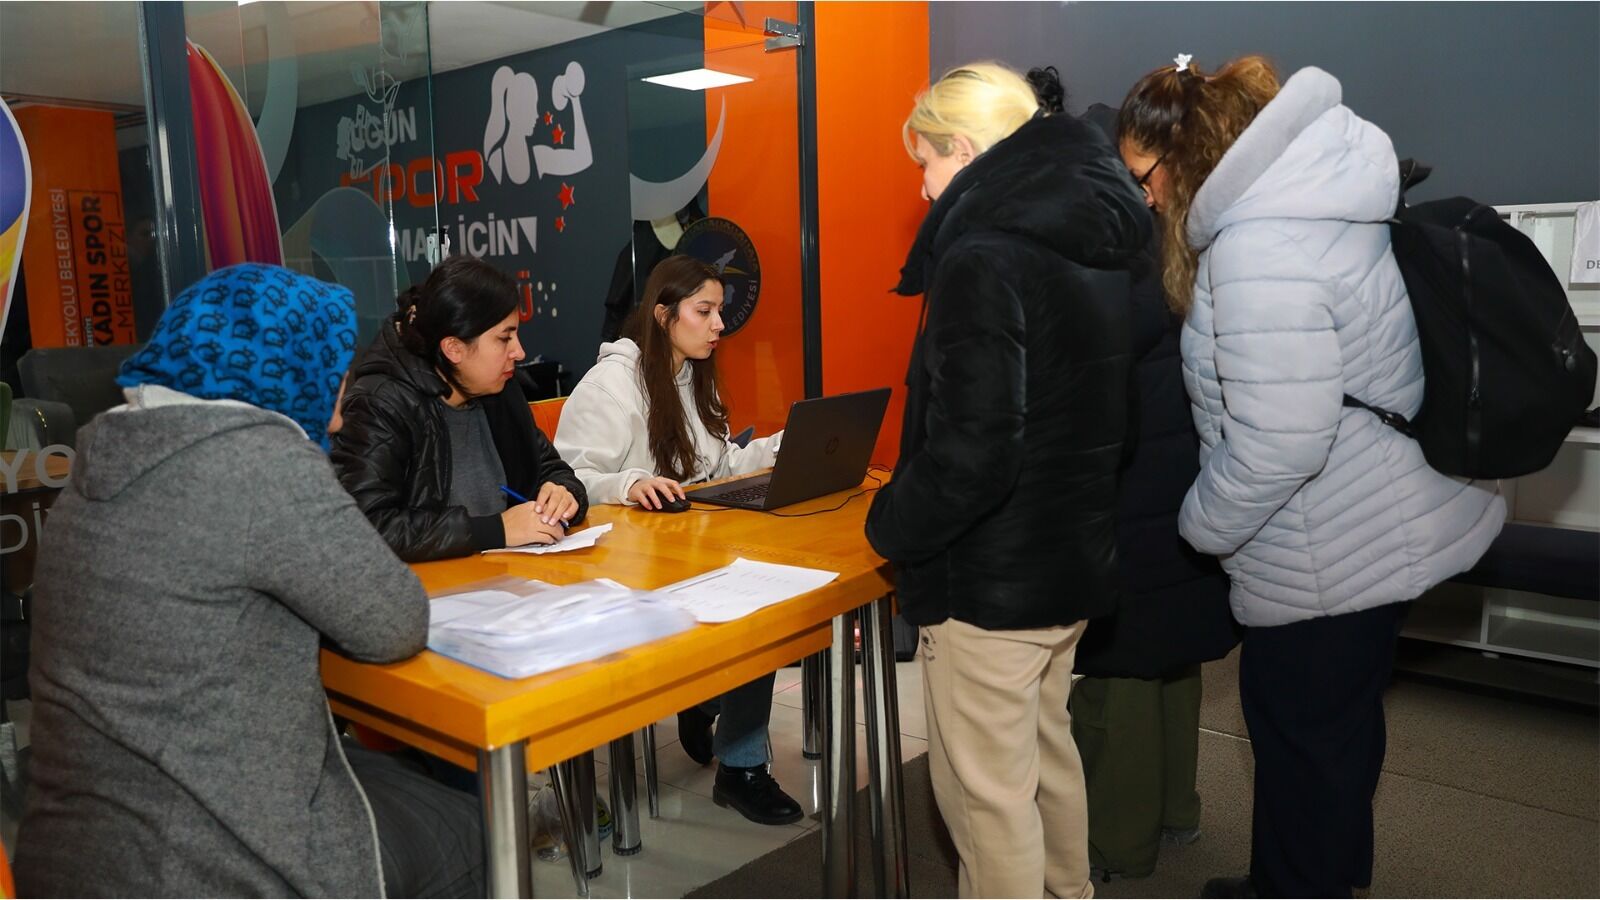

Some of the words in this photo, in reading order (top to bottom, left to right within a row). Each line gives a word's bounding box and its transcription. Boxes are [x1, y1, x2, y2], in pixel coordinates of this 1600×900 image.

[49, 188, 76, 280] BELEDİYESİ
[82, 195, 107, 266] SPOR
[104, 222, 132, 328] MERKEZİ
